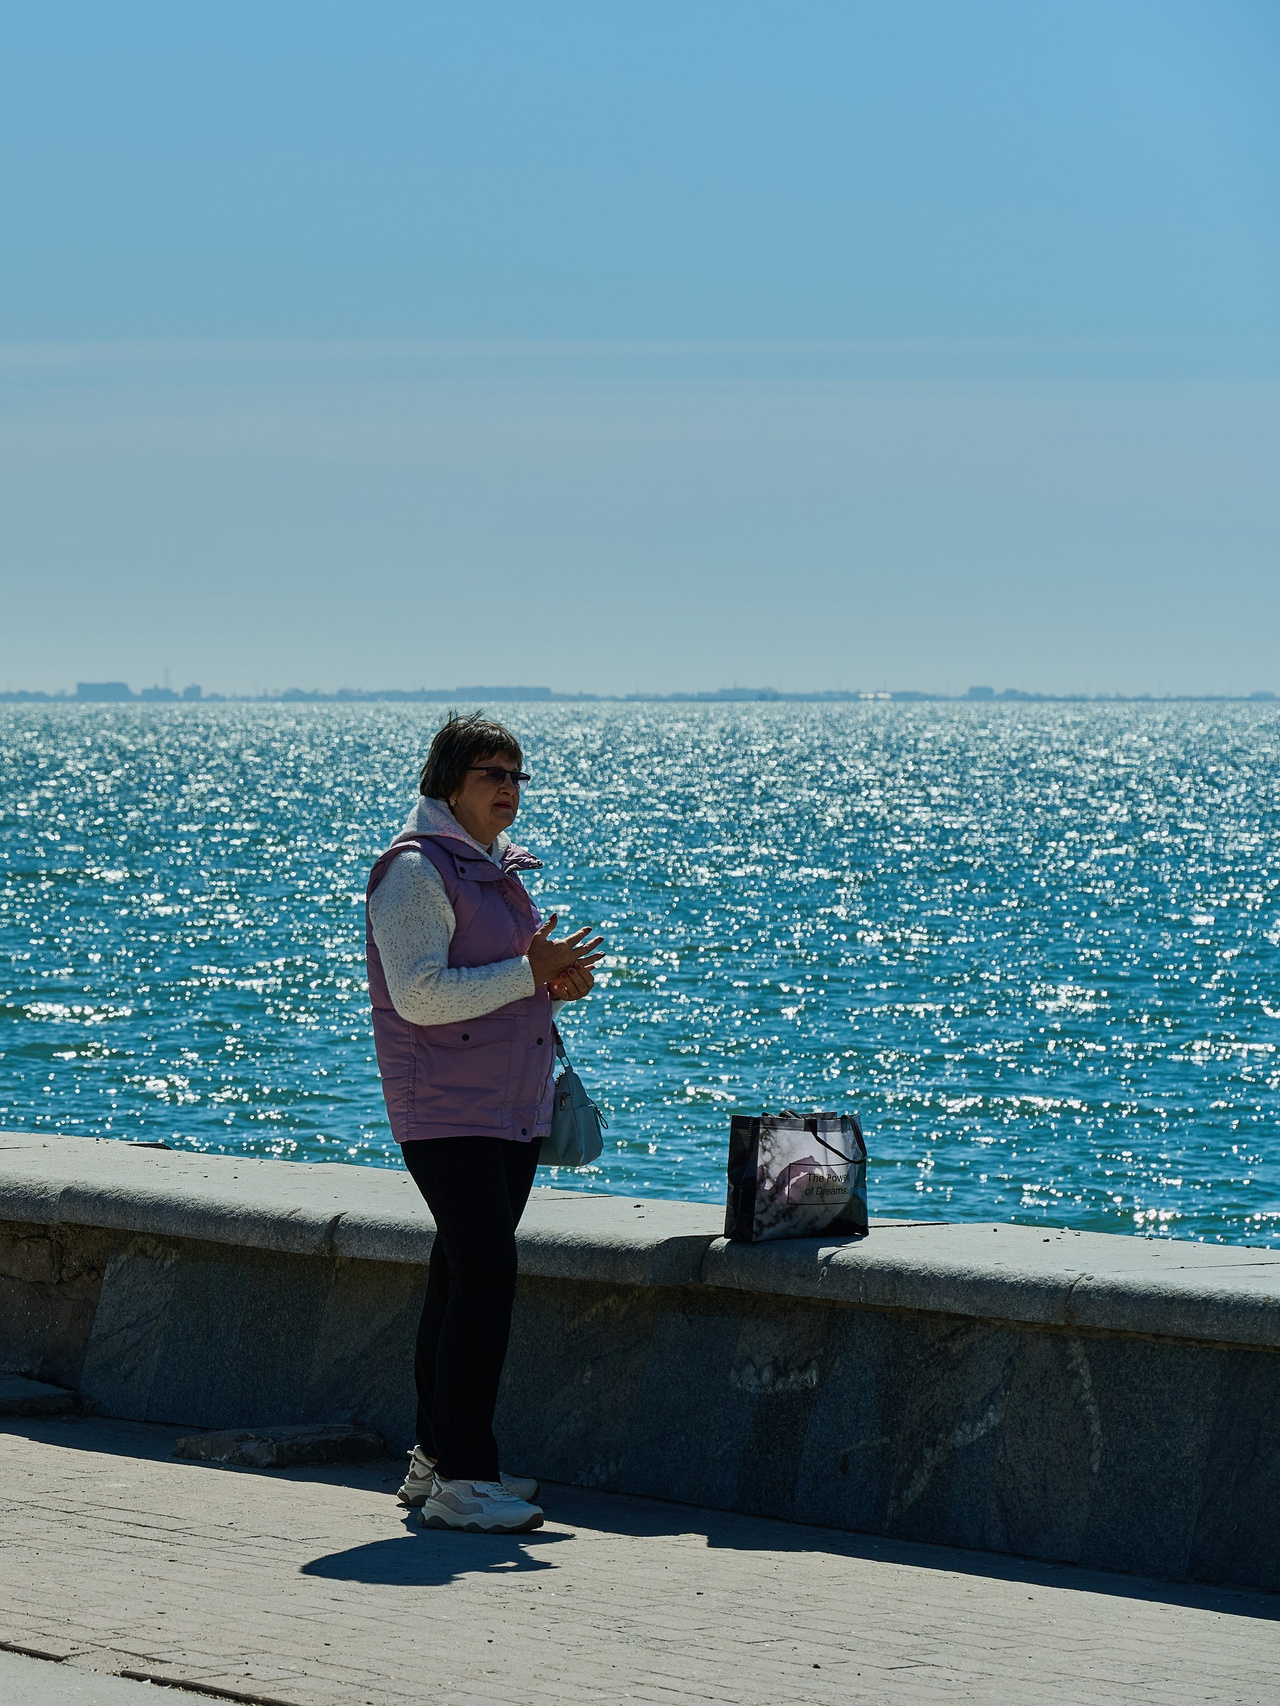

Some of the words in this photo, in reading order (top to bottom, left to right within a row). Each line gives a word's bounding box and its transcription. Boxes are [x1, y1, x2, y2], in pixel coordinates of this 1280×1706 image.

[808, 1173, 825, 1183] The
[827, 1173, 850, 1183] Powe
[805, 1186, 815, 1196] of
